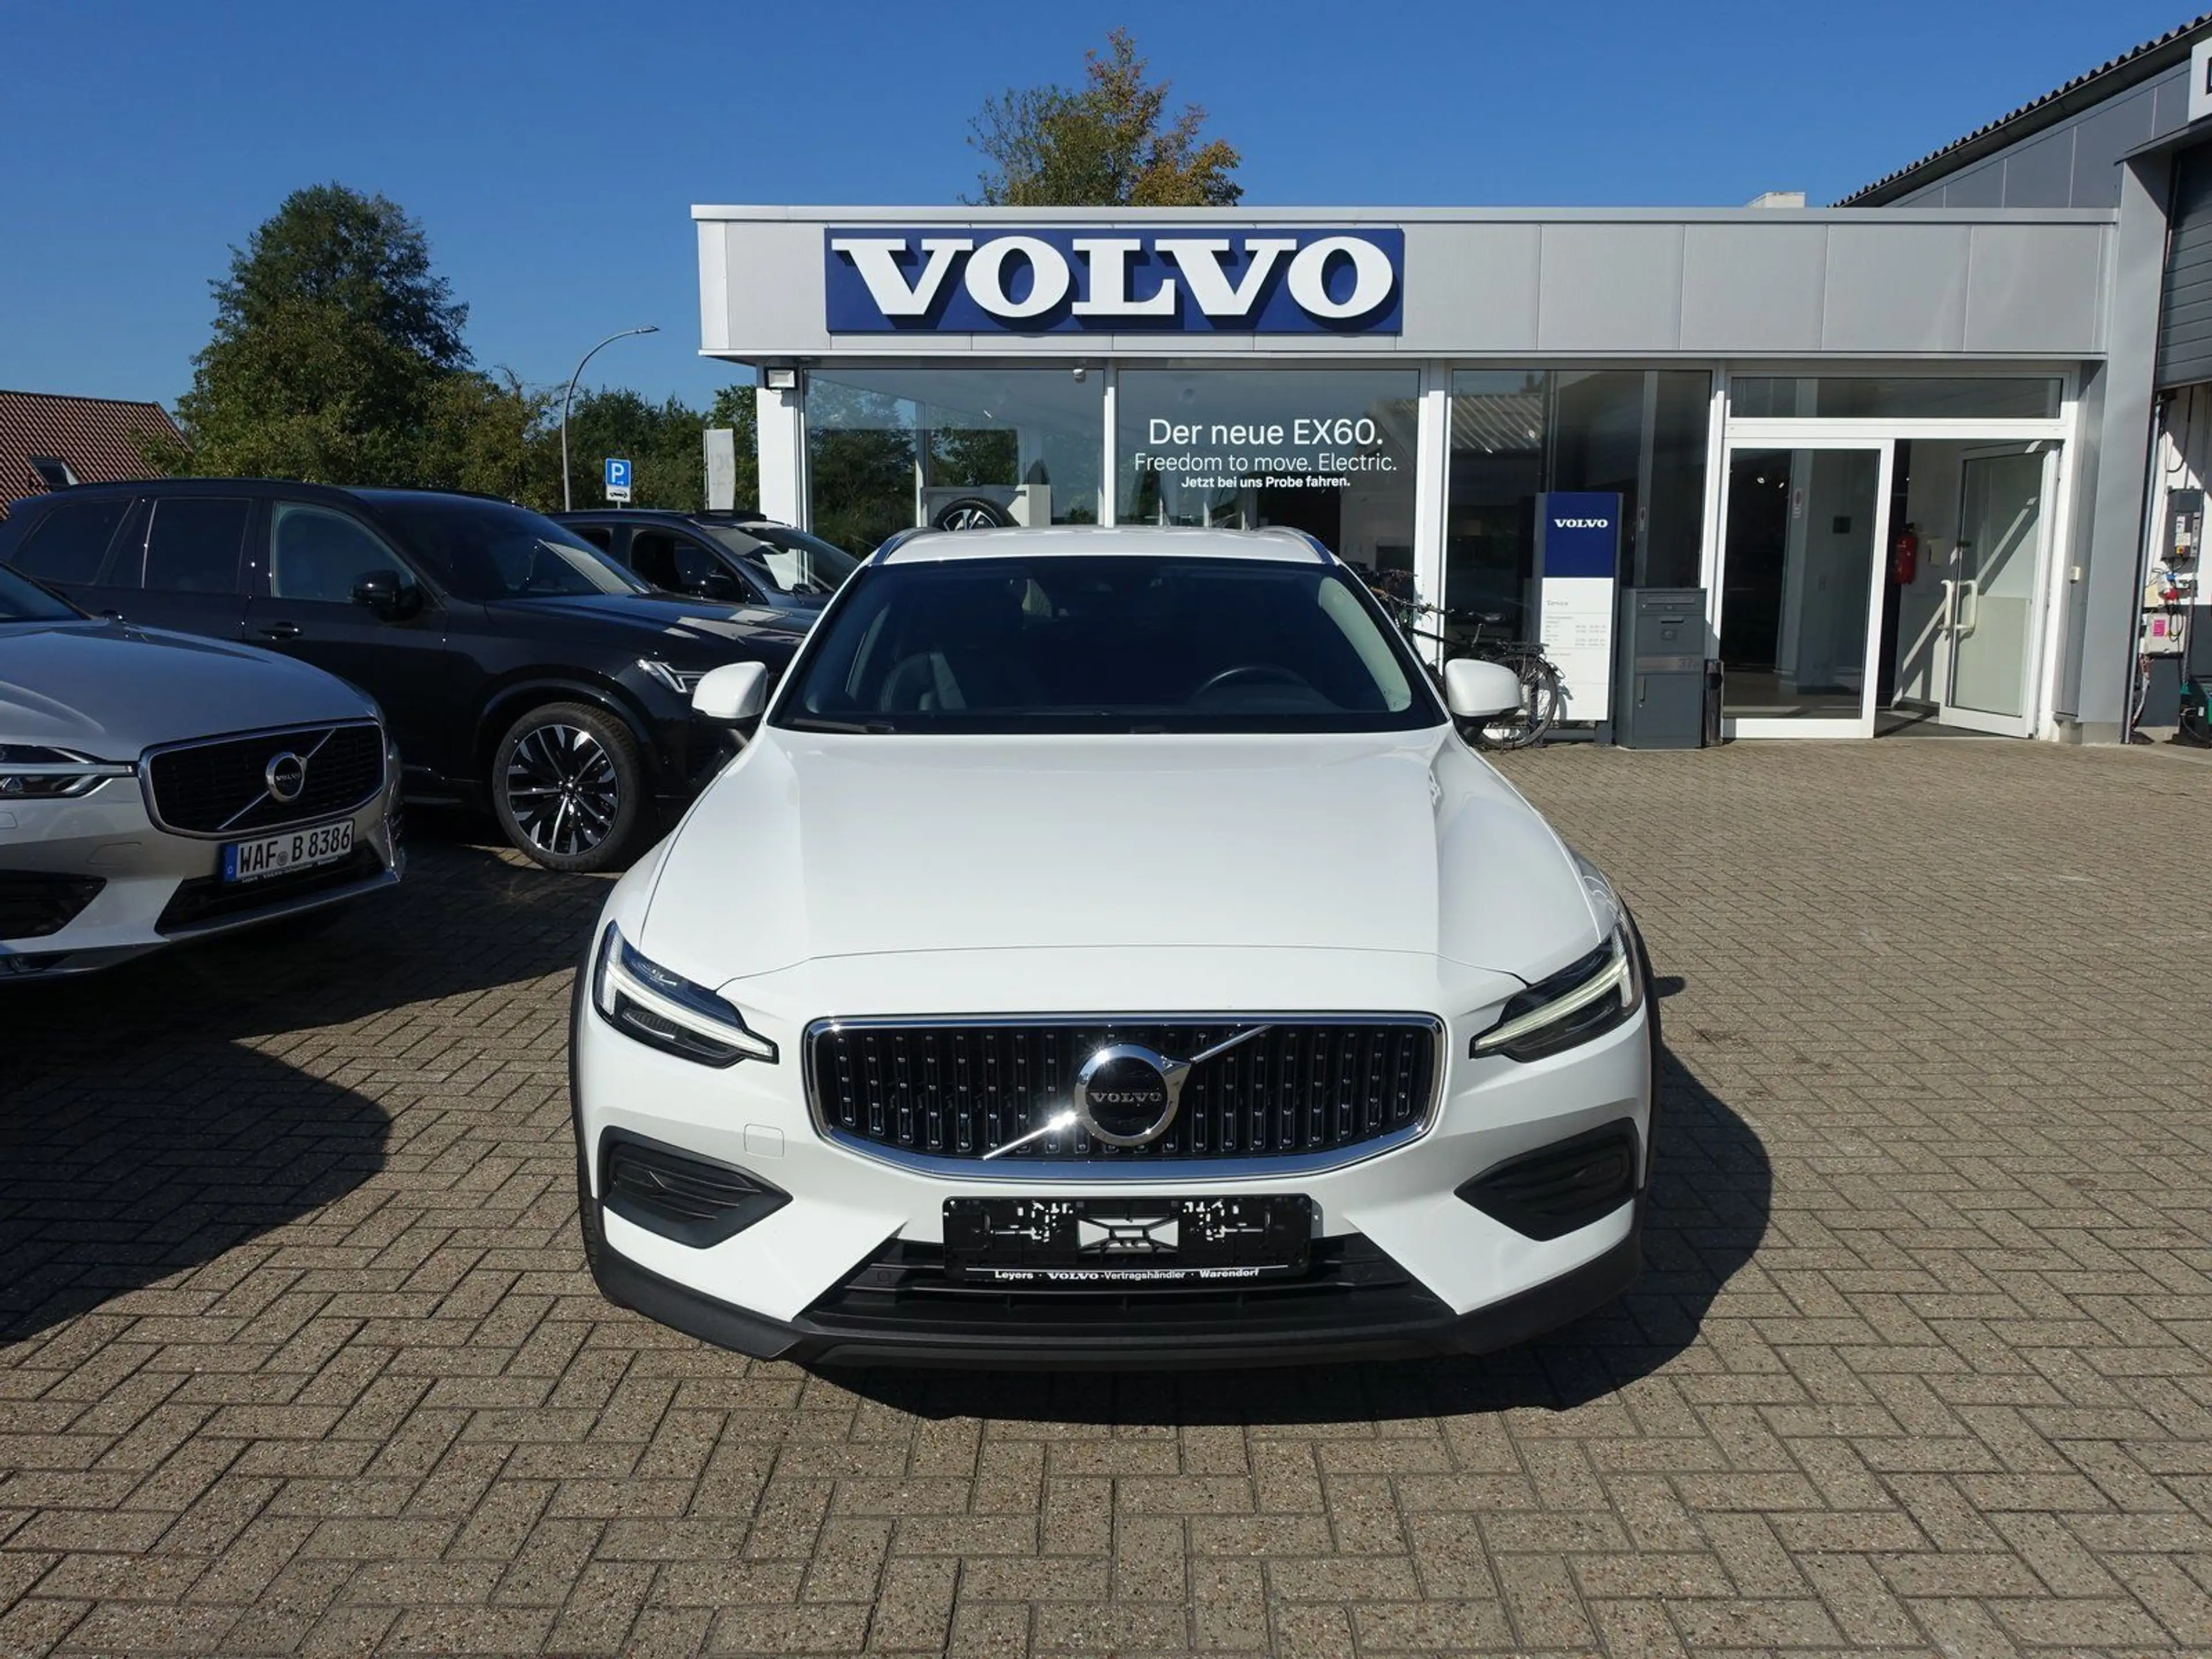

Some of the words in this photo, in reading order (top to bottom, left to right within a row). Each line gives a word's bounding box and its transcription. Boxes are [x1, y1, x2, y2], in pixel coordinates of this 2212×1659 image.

[832, 236, 1392, 318] VOLVO
[1149, 418, 1203, 445] Der
[1211, 425, 1284, 445] neue
[1293, 418, 1383, 445] EX60.
[1135, 452, 1222, 471] Freedom
[1228, 454, 1248, 471] to
[1254, 457, 1312, 471] move.
[1318, 452, 1397, 471] Electric.
[612, 463, 624, 483] P
[1181, 477, 1215, 488] Jetzt
[1218, 476, 1237, 488] bei
[1240, 479, 1263, 488] uns
[1266, 476, 1304, 488] Probe
[1305, 475, 1351, 487] fahren.
[1554, 519, 1608, 528] VOLVO
[240, 841, 278, 873] WAF
[292, 836, 303, 862] B
[308, 825, 350, 858] 8386
[1090, 1092, 1162, 1102] VOLVO
[995, 1270, 1033, 1280] Leyers
[1200, 1268, 1259, 1278] Warendorf
